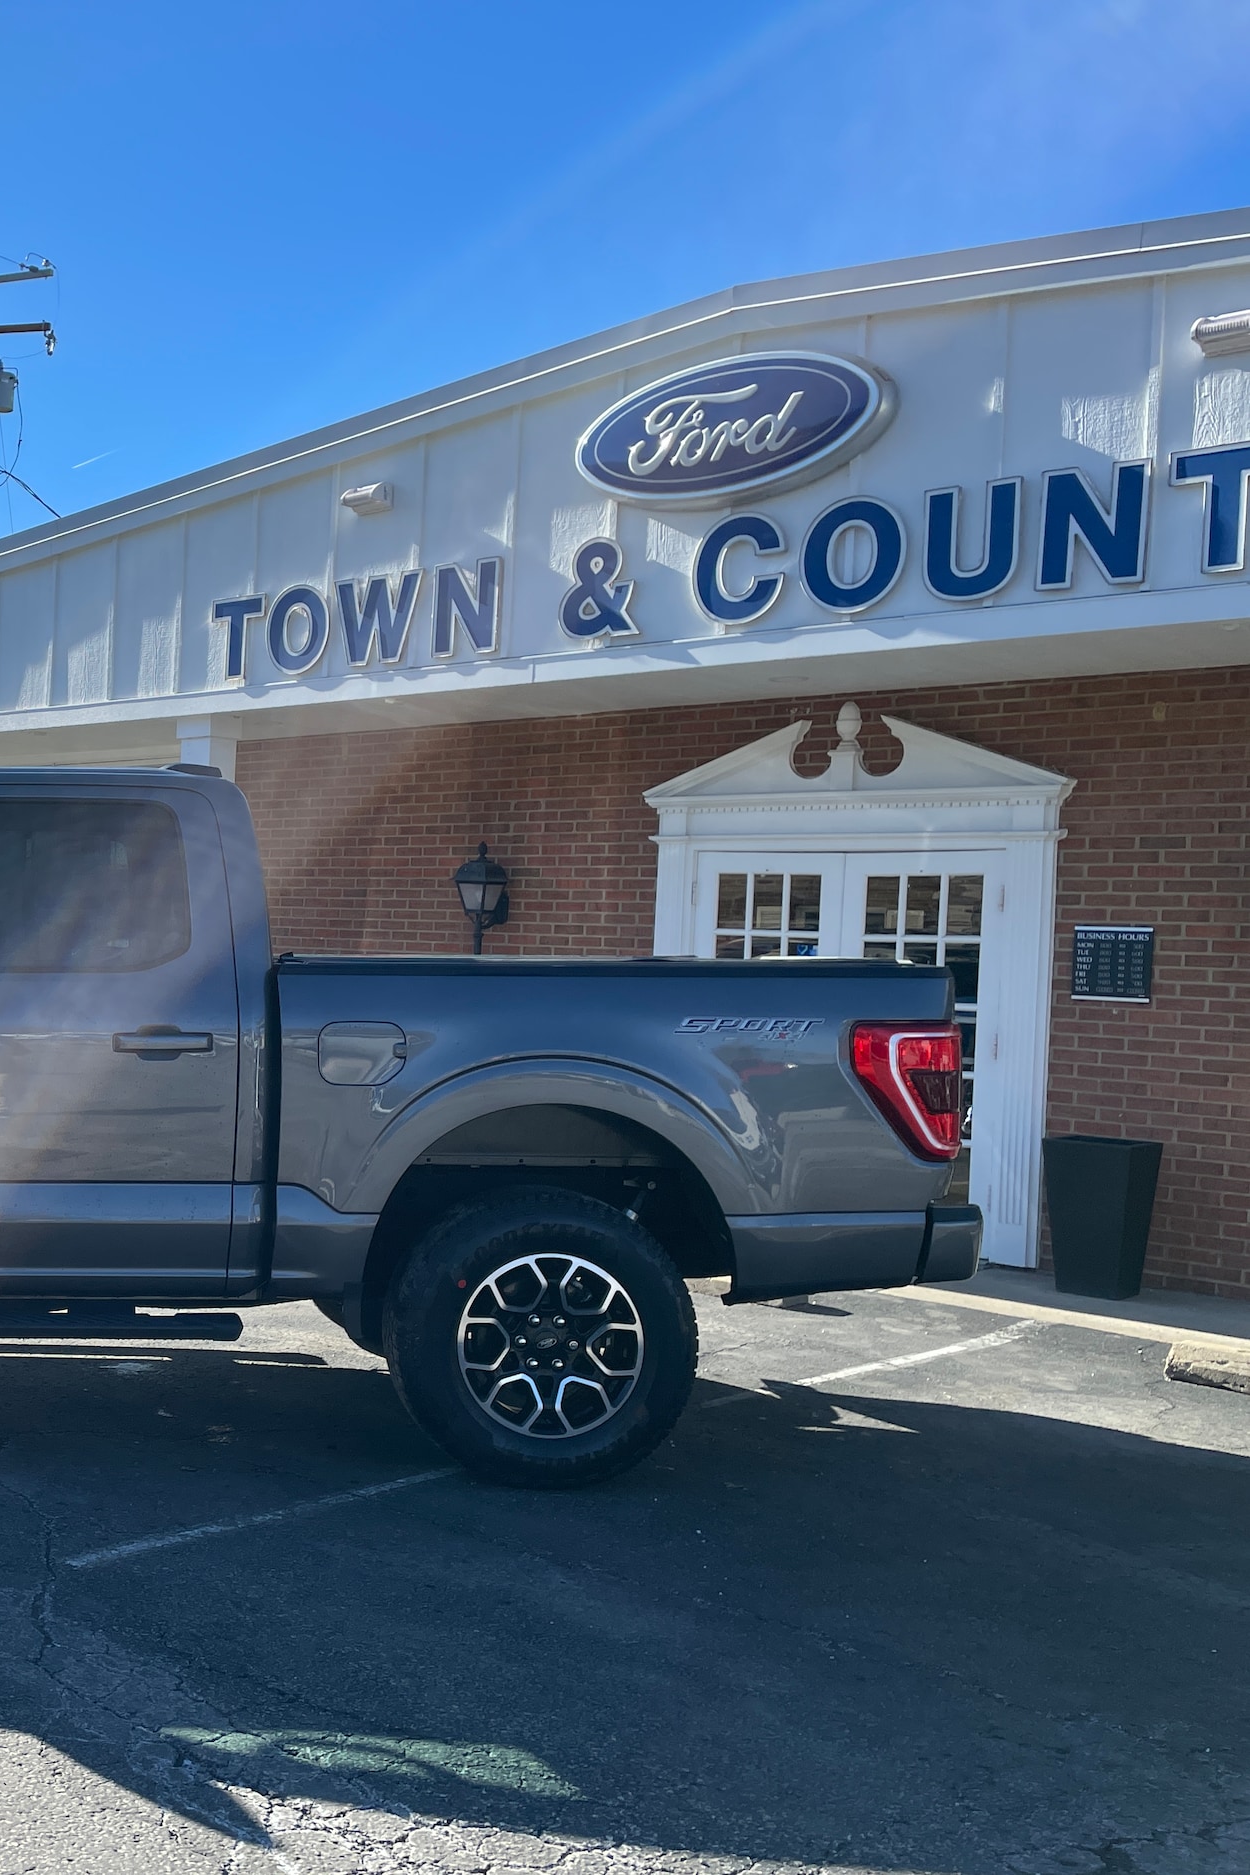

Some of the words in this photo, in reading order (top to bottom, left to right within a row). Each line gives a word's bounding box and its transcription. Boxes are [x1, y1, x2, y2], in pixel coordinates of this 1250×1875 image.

[628, 383, 805, 476] Ford
[212, 555, 502, 682] TOWN
[557, 535, 640, 640] &
[690, 440, 1250, 626] COUNT
[1076, 932, 1116, 940] BUSINESS
[1118, 933, 1150, 941] HOURS
[674, 1016, 826, 1036] SPORT
